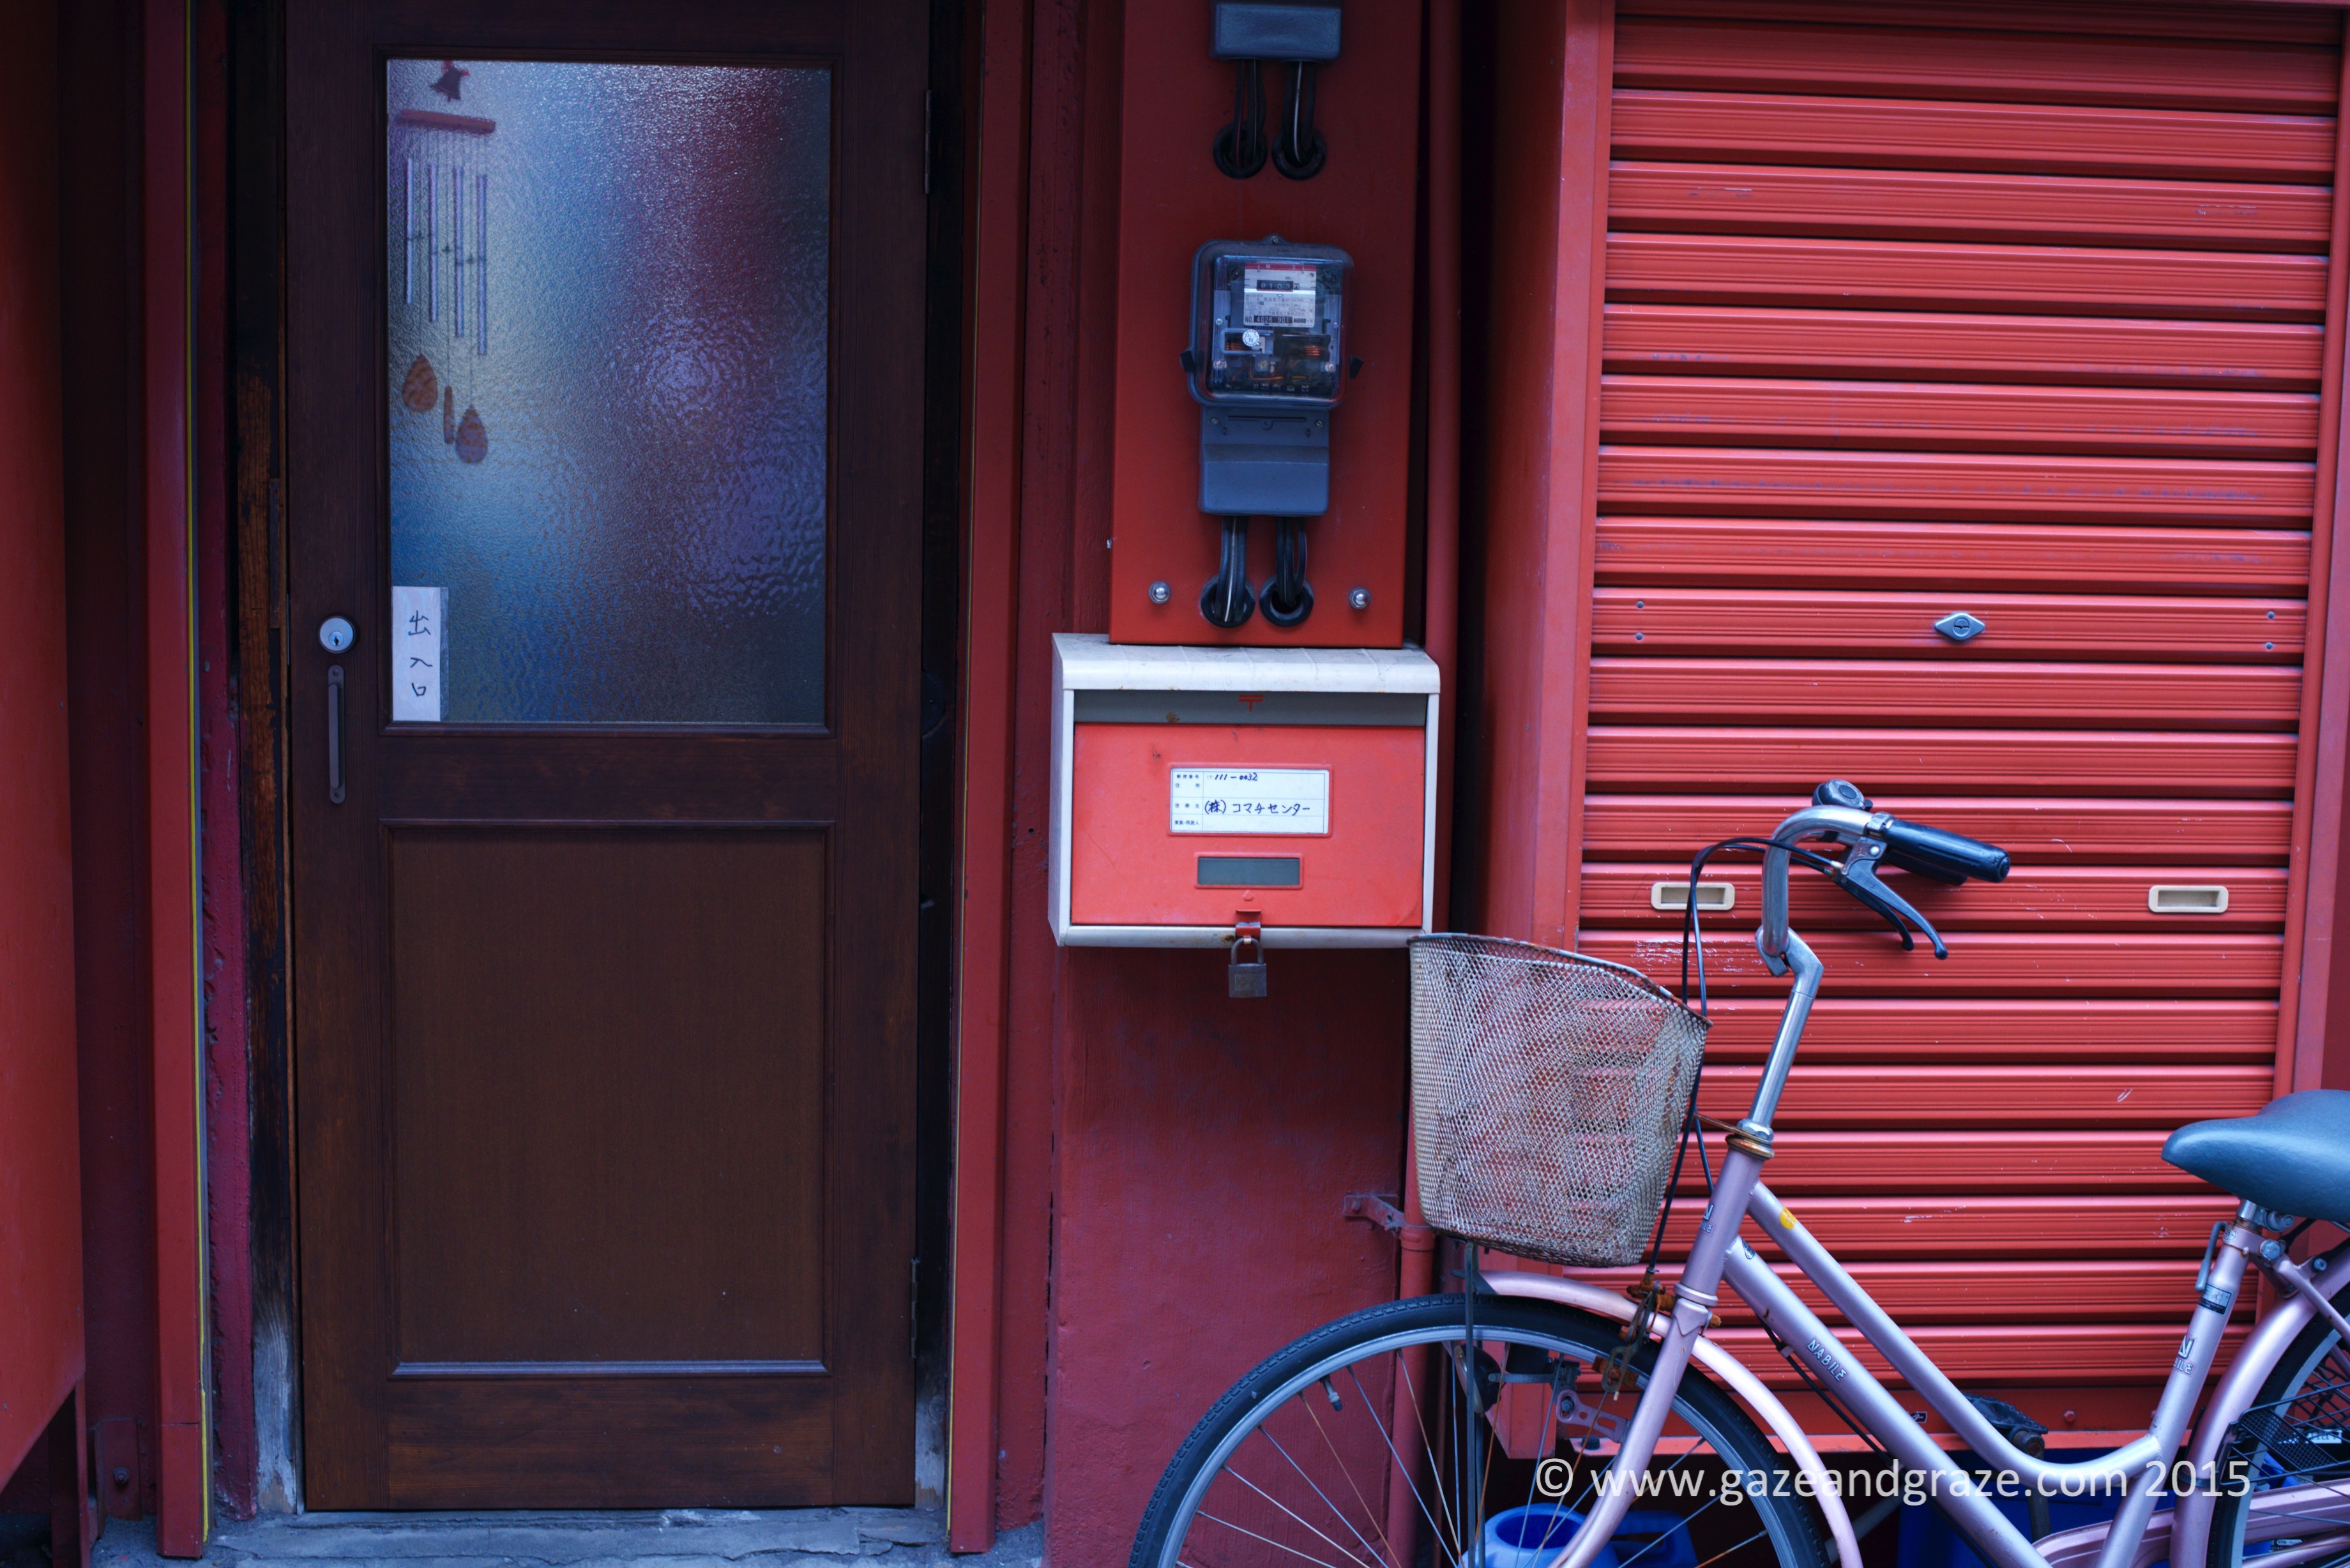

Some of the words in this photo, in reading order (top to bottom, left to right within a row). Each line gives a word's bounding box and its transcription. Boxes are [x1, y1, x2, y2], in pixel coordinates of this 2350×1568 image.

[408, 610, 433, 697] 出入口
[1807, 1338, 1847, 1382] NABILE
